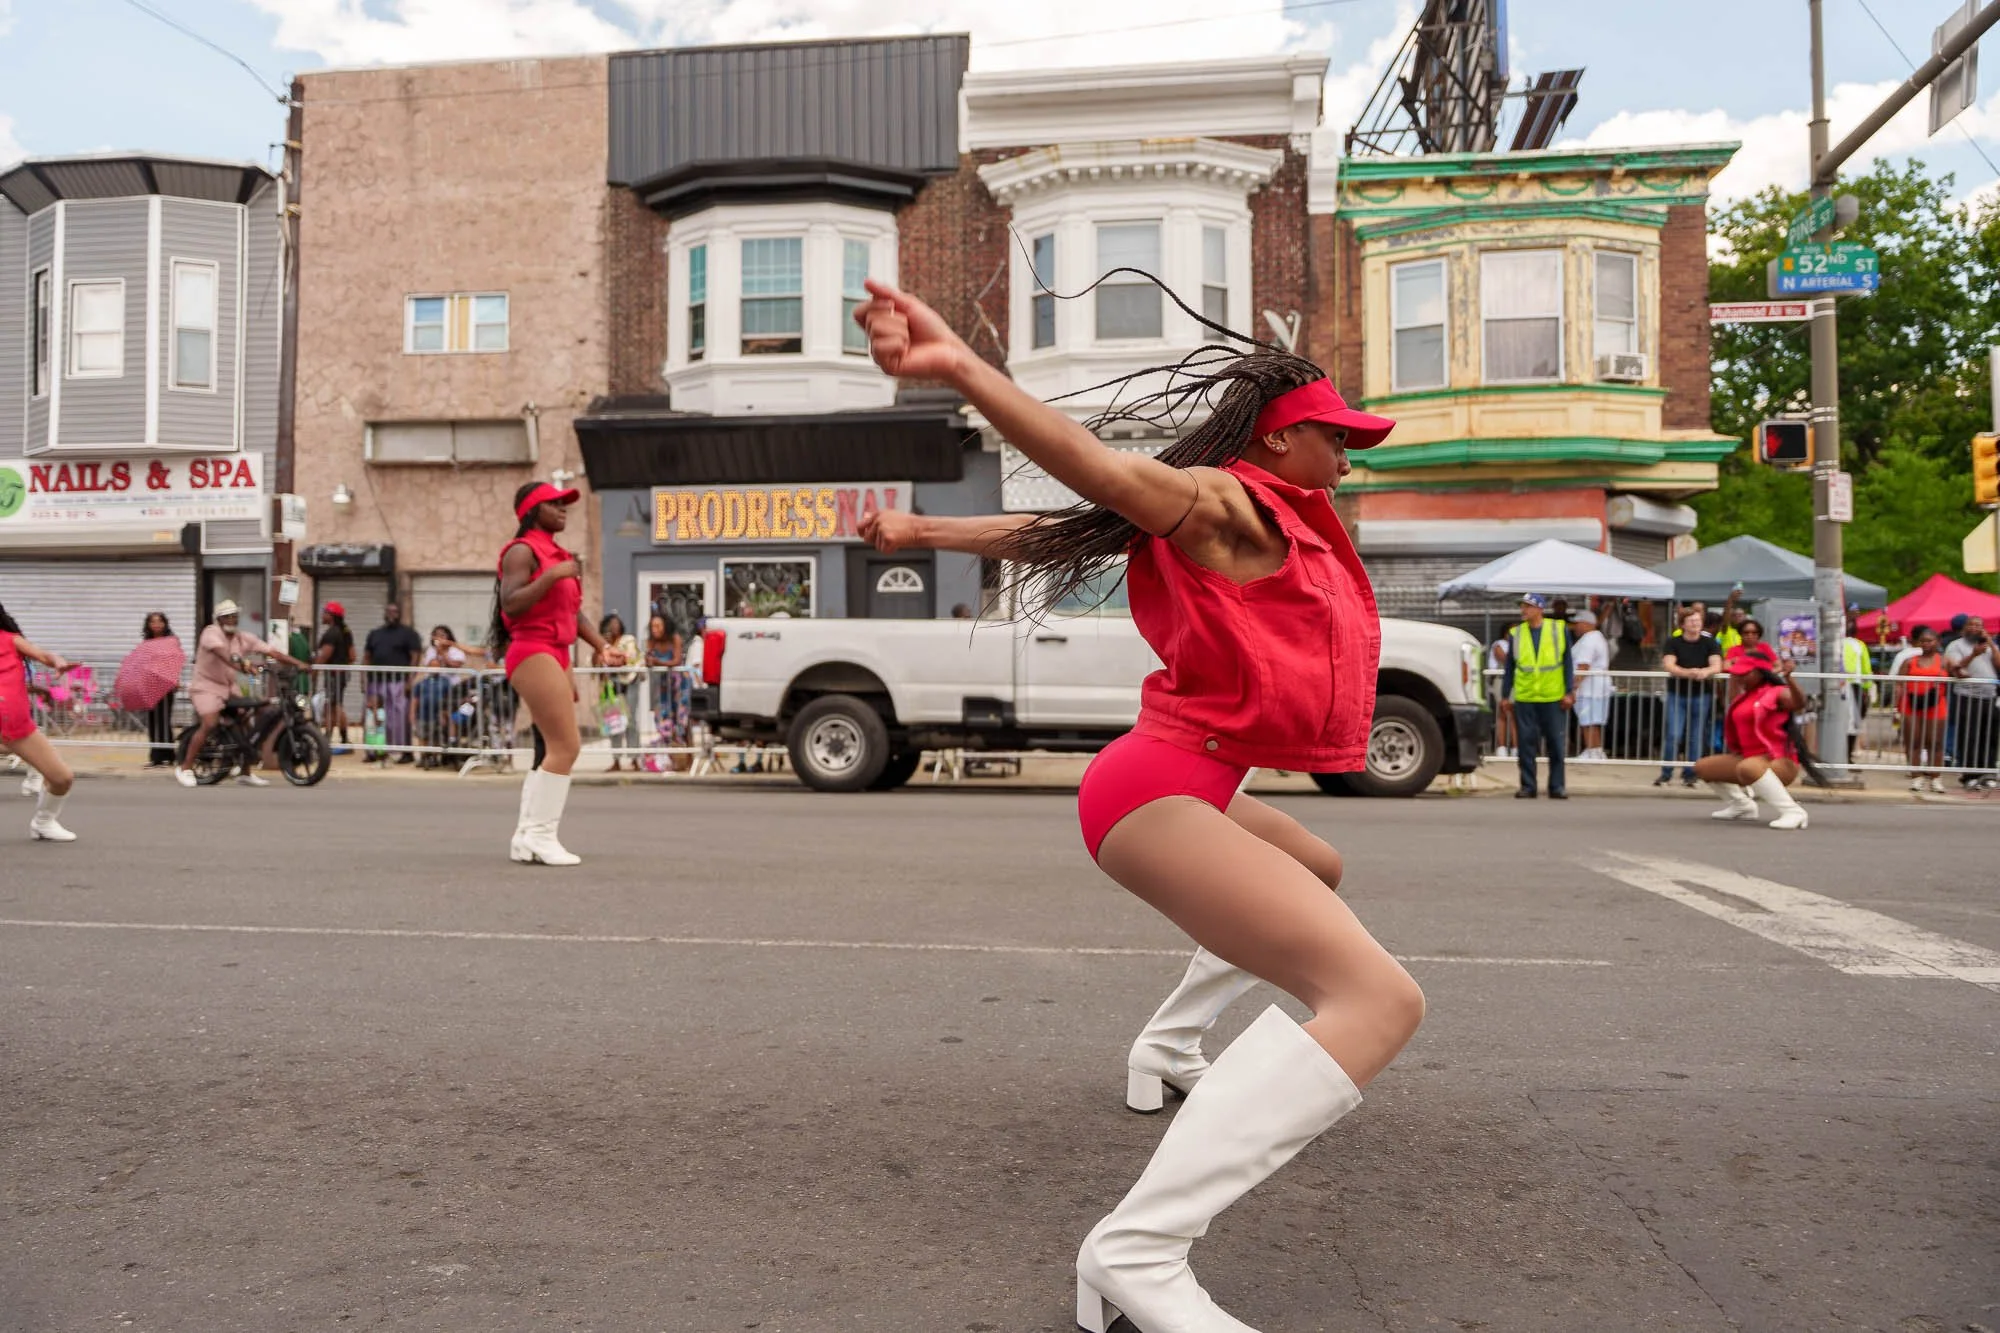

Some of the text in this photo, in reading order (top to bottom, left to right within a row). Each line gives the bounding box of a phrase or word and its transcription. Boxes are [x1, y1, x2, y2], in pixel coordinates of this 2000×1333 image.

[1788, 213, 1816, 247] PINE
[1819, 207, 1831, 227] ST
[1799, 252, 1874, 274] 52ND ST
[1783, 273, 1873, 290] N ARTERIAL S
[29, 458, 256, 493] NAILS & SPA
